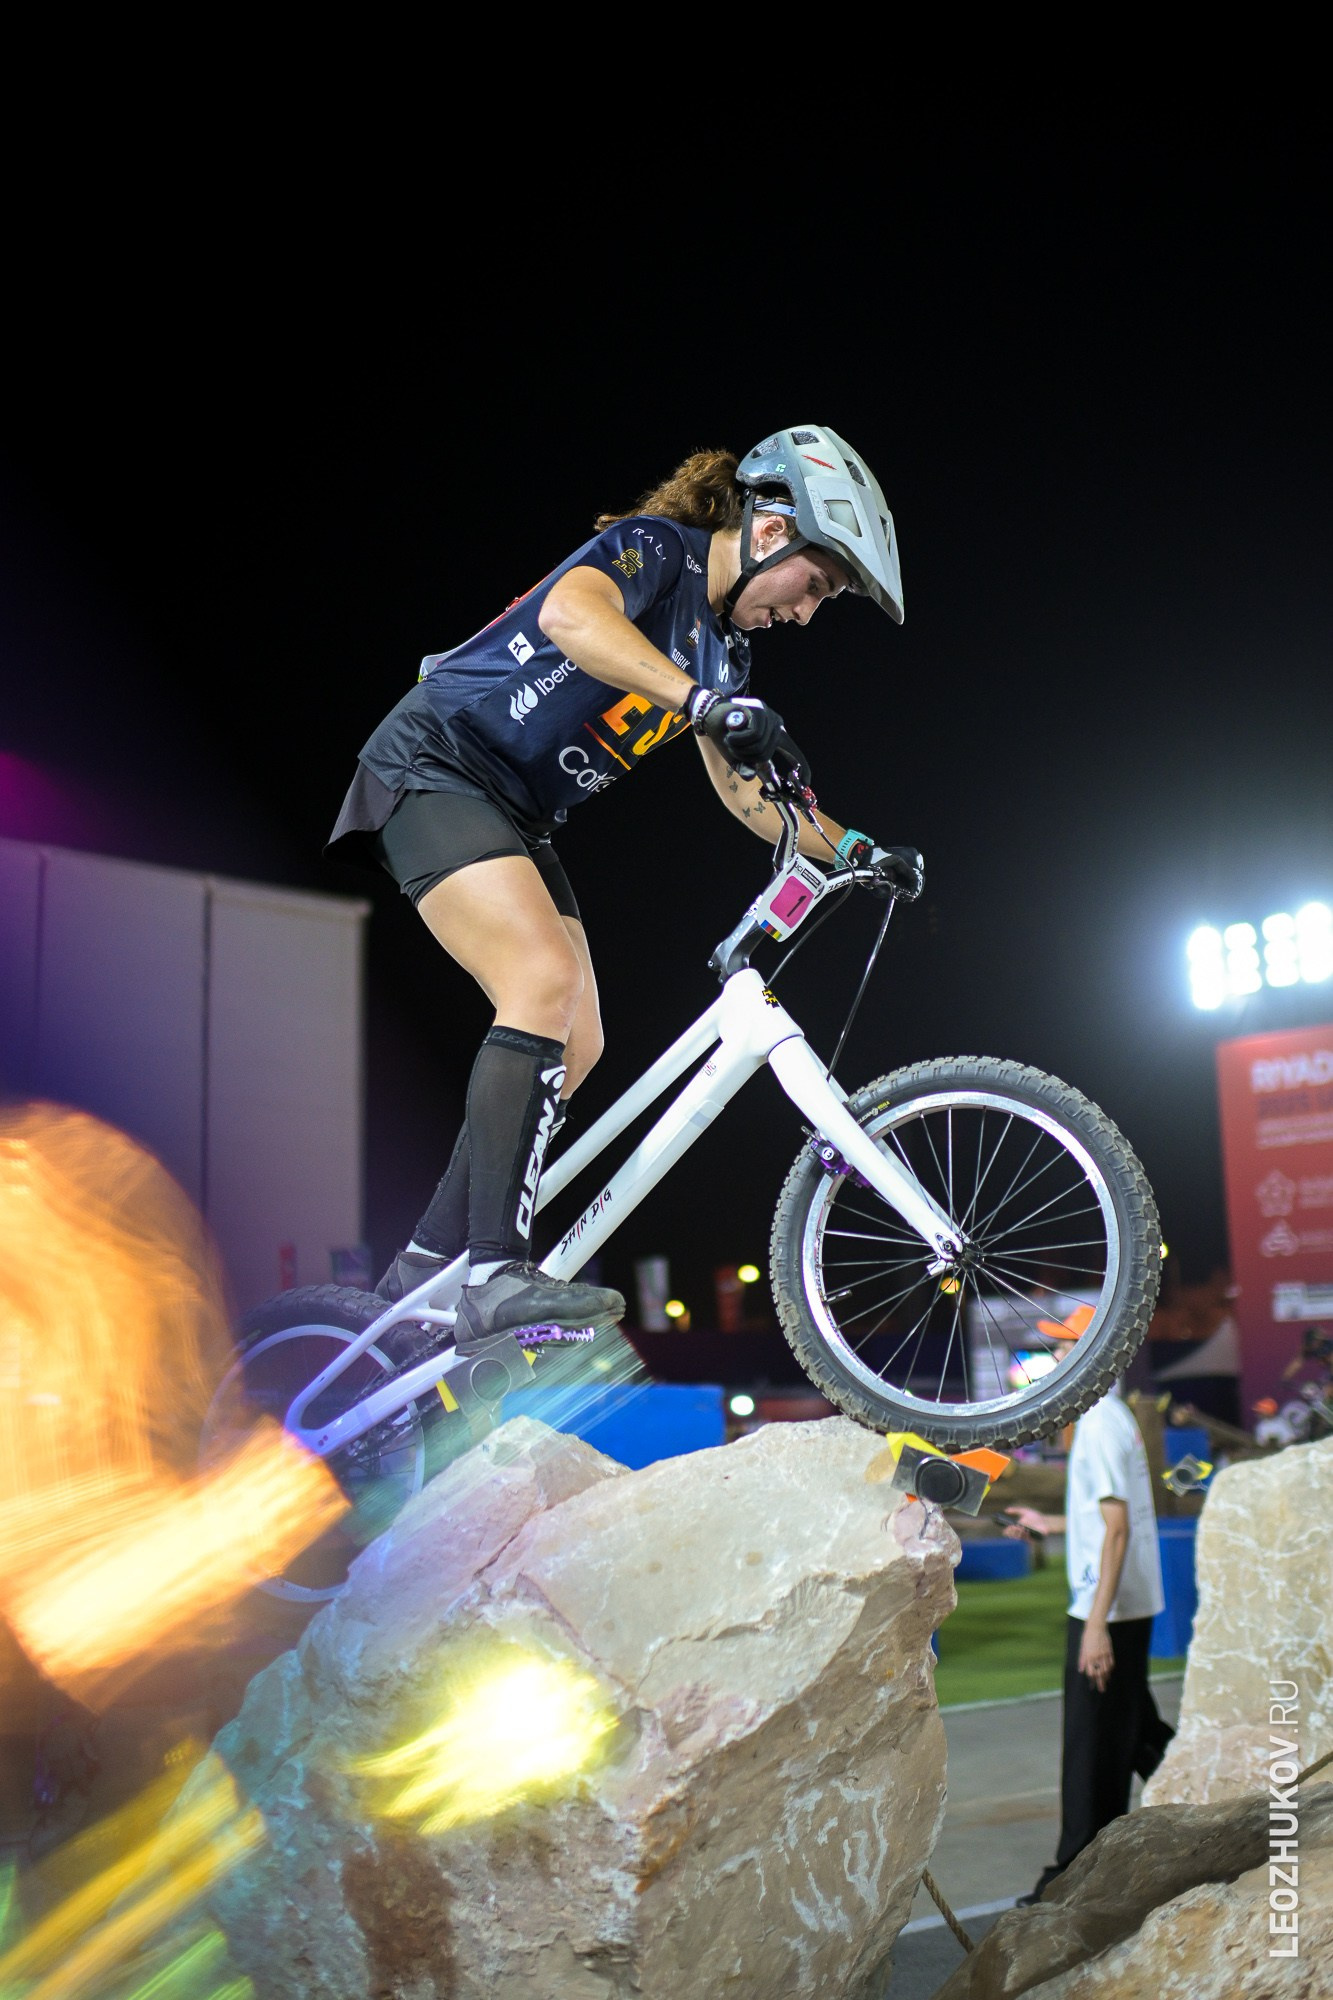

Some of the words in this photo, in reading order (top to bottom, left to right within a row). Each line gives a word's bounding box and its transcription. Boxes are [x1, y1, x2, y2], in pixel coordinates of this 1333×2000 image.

[632, 527, 667, 561] RAL
[601, 692, 684, 756] ES
[786, 895, 807, 918] 1
[561, 1213, 587, 1256] SHIN
[590, 1188, 612, 1218] DIG
